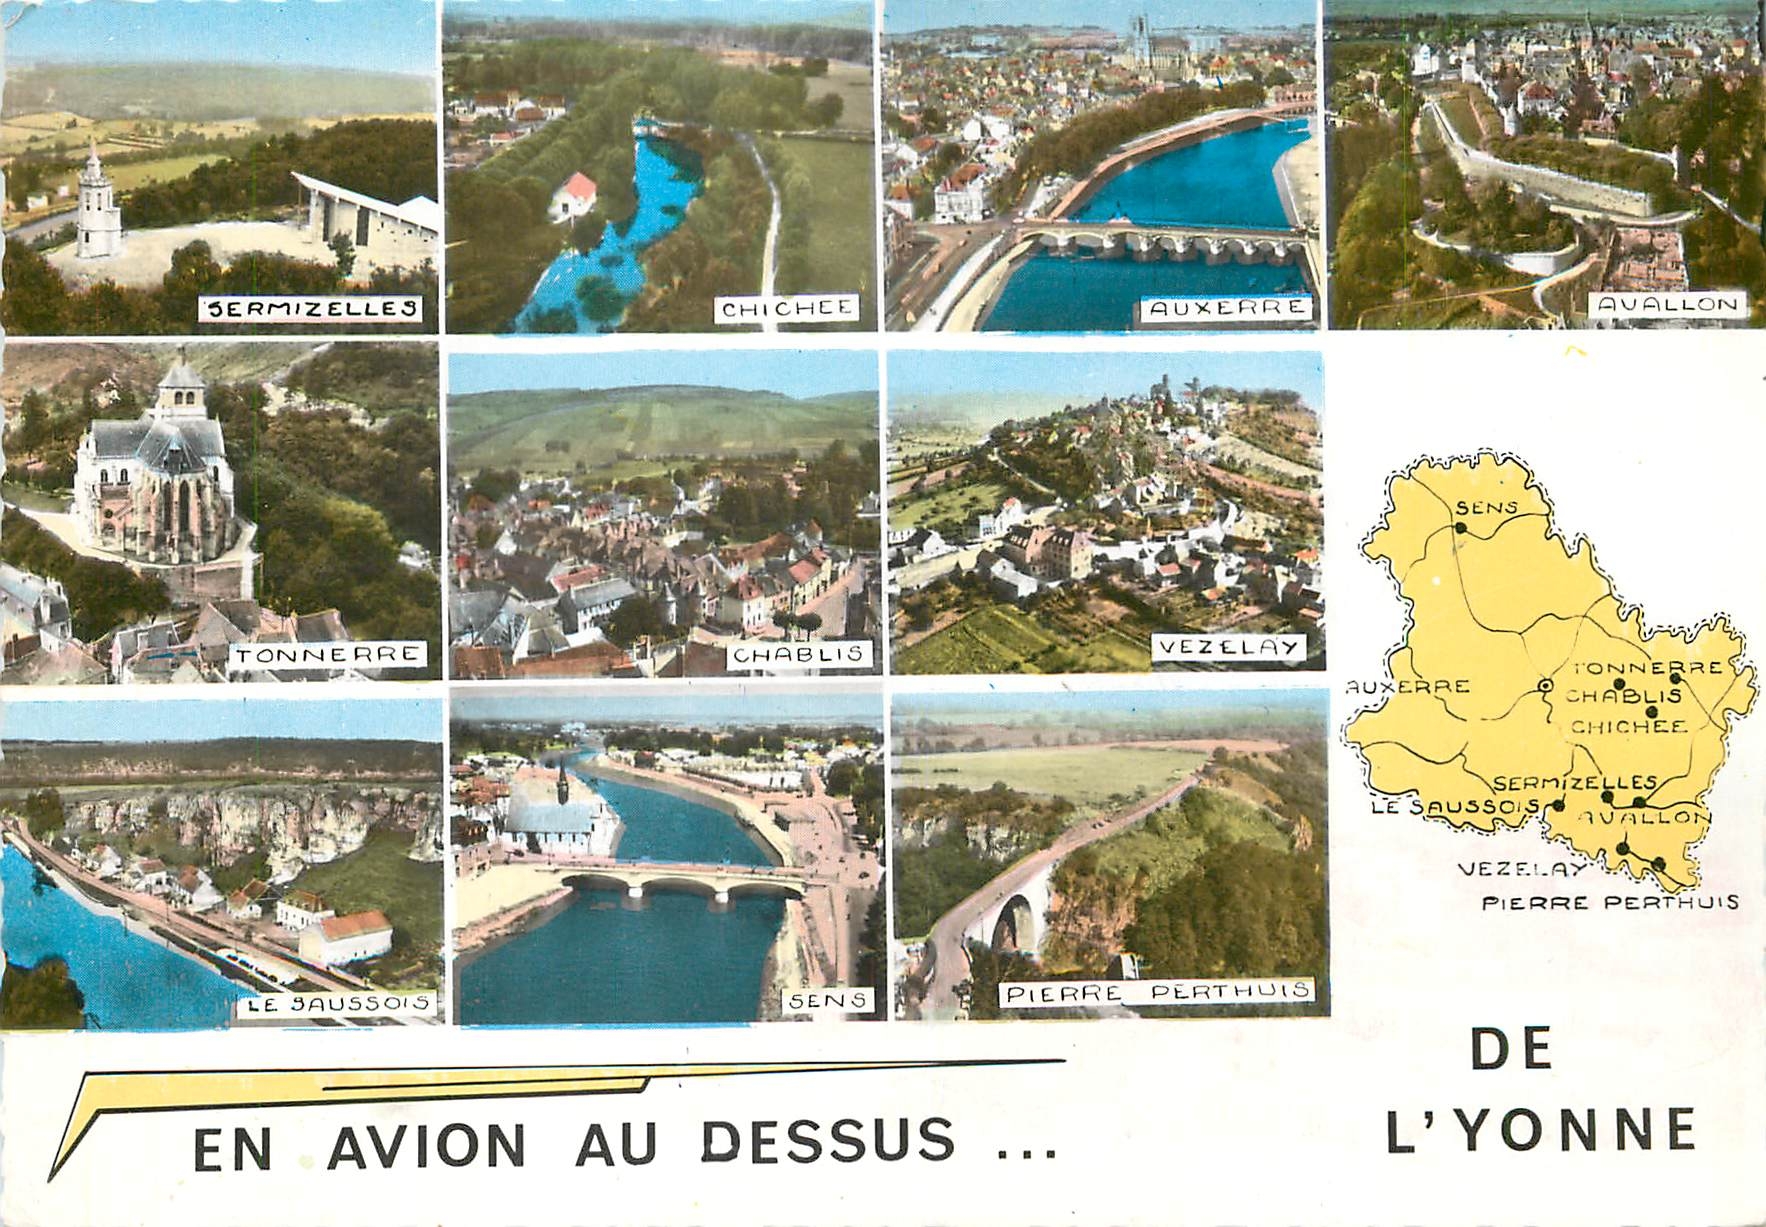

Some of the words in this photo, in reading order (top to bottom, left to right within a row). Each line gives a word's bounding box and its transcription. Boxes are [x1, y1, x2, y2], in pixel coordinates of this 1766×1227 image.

[207, 300, 417, 320] SERMIZELLES
[722, 299, 853, 319] CHICHEE
[1149, 300, 1308, 318] AUXERRE
[1598, 296, 1740, 312] AVALLON
[1456, 499, 1518, 517] SENS
[237, 647, 419, 666] TONNERRE
[733, 647, 864, 665] CHABLIS
[1160, 638, 1298, 658] VEZELAY
[1575, 660, 1723, 677] TONNERRE
[1346, 678, 1469, 696] AUXERRE
[1566, 688, 1682, 705] CHABLIS
[1572, 719, 1688, 735] CHICHEE
[1494, 774, 1657, 793] SERMIZELLES
[1372, 799, 1402, 815] LE
[1410, 798, 1540, 815] SAUSSOIS
[1577, 809, 1712, 826] AVALLON
[1458, 860, 1587, 878] VEZELAY
[1482, 895, 1589, 911] PIERRE
[1605, 894, 1739, 911] PERTHUIS
[788, 993, 866, 1010] SENS
[1006, 984, 1122, 1004] PIERRE
[1152, 983, 1309, 1001] PERTHUIS
[248, 998, 278, 1013] LE
[291, 994, 430, 1012] SAUSSOIS
[1471, 1026, 1553, 1071] DE
[1387, 1107, 1697, 1154] L'YONNE
[195, 1128, 271, 1172] EN
[328, 1123, 526, 1169] AVION
[575, 1122, 655, 1166] AU
[703, 1115, 955, 1162] DESSUS
